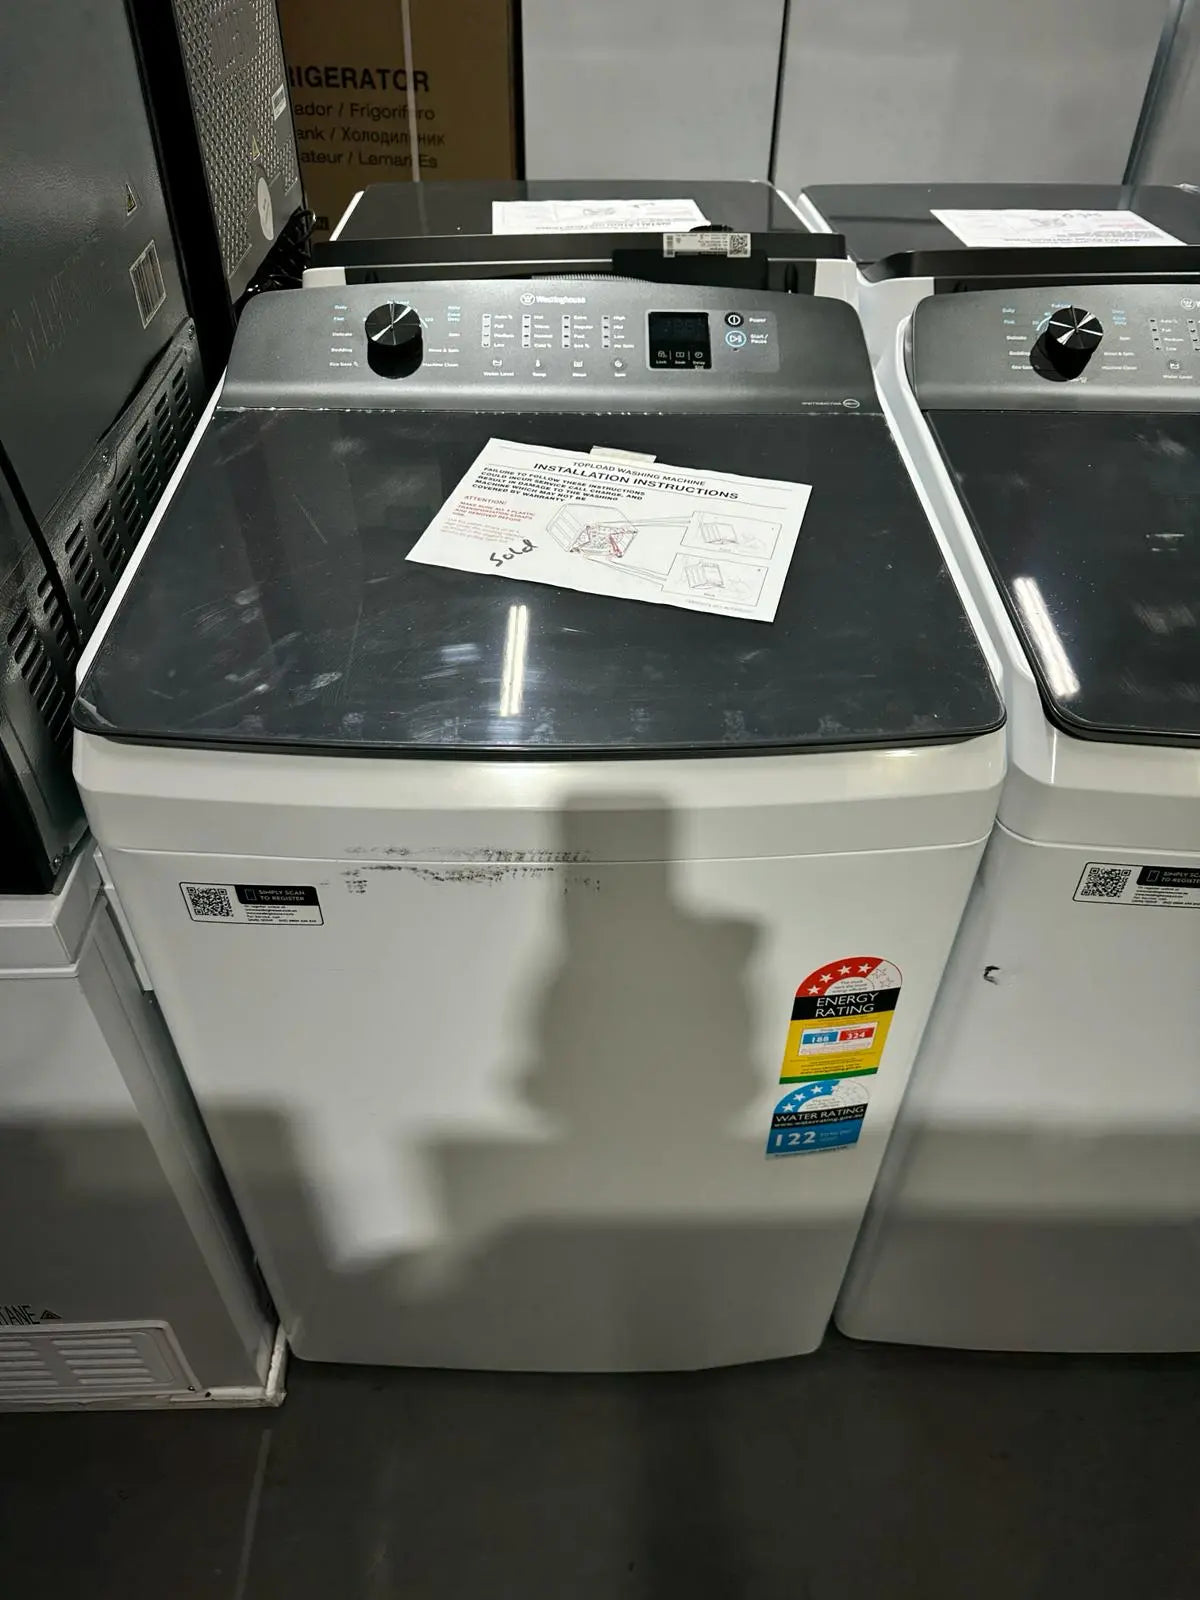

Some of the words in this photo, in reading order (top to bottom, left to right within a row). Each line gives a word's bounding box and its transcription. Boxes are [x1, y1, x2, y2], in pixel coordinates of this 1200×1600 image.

[350, 102, 435, 121] Frigorifro
[341, 127, 446, 146] Холодилник
[536, 295, 587, 304] Westinghouse
[481, 471, 507, 479] COULD
[534, 480, 566, 488] SERVICE
[484, 467, 515, 476] FAILURE
[529, 473, 562, 483] FOLLOW
[588, 484, 646, 496] INSTRUCTIONS
[534, 463, 630, 484] INSTALLATION
[633, 478, 739, 500] INSTRUCTIONS
[573, 462, 615, 472] TOPLOAD
[618, 468, 660, 480] WASHING
[662, 475, 706, 487] MACHINE
[472, 484, 509, 493] COVERED
[522, 492, 565, 502] WARRANTY
[475, 480, 510, 488] MACHINE
[512, 485, 538, 493] WHICH
[478, 475, 506, 483] RESULT
[518, 482, 551, 491] DAMAGE
[583, 492, 618, 501] WASHING
[816, 992, 880, 1007] ENERGY
[816, 1004, 875, 1018] RATING
[776, 1112, 818, 1122] WATER
[820, 1106, 864, 1118] RATING
